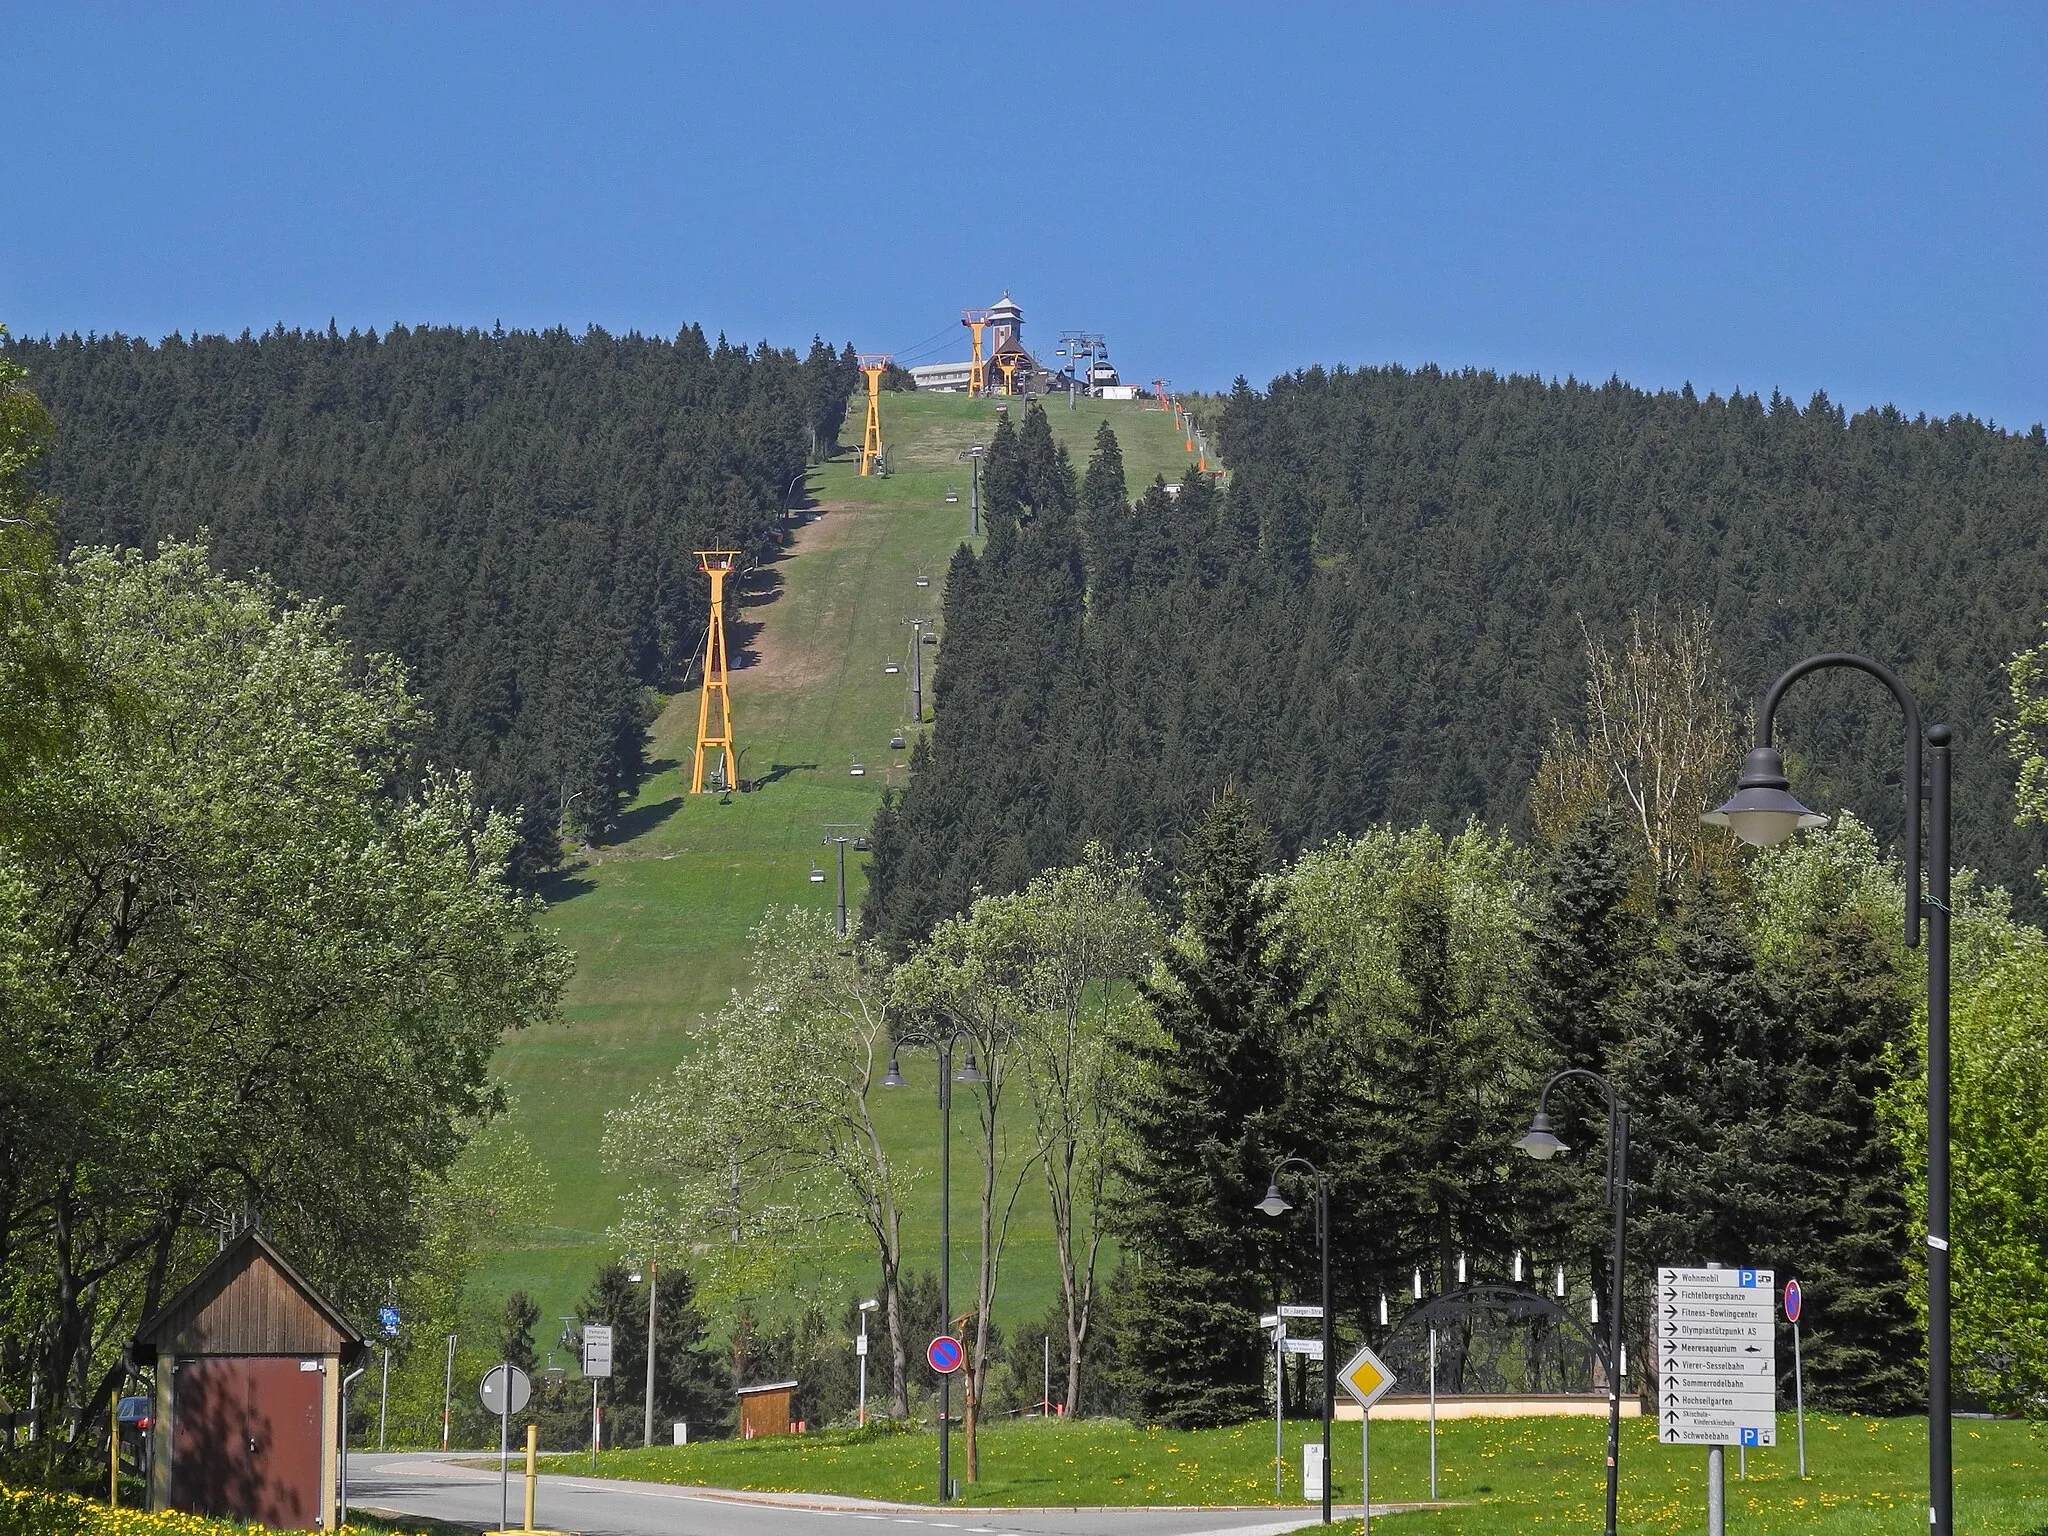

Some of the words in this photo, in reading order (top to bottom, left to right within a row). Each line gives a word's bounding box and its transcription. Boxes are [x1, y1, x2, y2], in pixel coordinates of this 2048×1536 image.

[1682, 1273, 1719, 1282] Wohnmobil
[1742, 1272, 1752, 1286] P
[1681, 1290, 1746, 1301] Fichtelbergschanze
[1681, 1308, 1758, 1319] Fitness-Bowlingcenter
[1682, 1325, 1744, 1336] Olympiastützpunkt
[1747, 1328, 1757, 1336] AS
[1681, 1343, 1737, 1354] Meeresaquarium
[1682, 1359, 1745, 1371] Vierer-Sesselbahn
[1682, 1378, 1744, 1388] Sommerrodelbahn
[1682, 1396, 1733, 1407] Hochseilgarten
[1683, 1431, 1729, 1441] Schwebebahn
[1744, 1430, 1754, 1444] P
